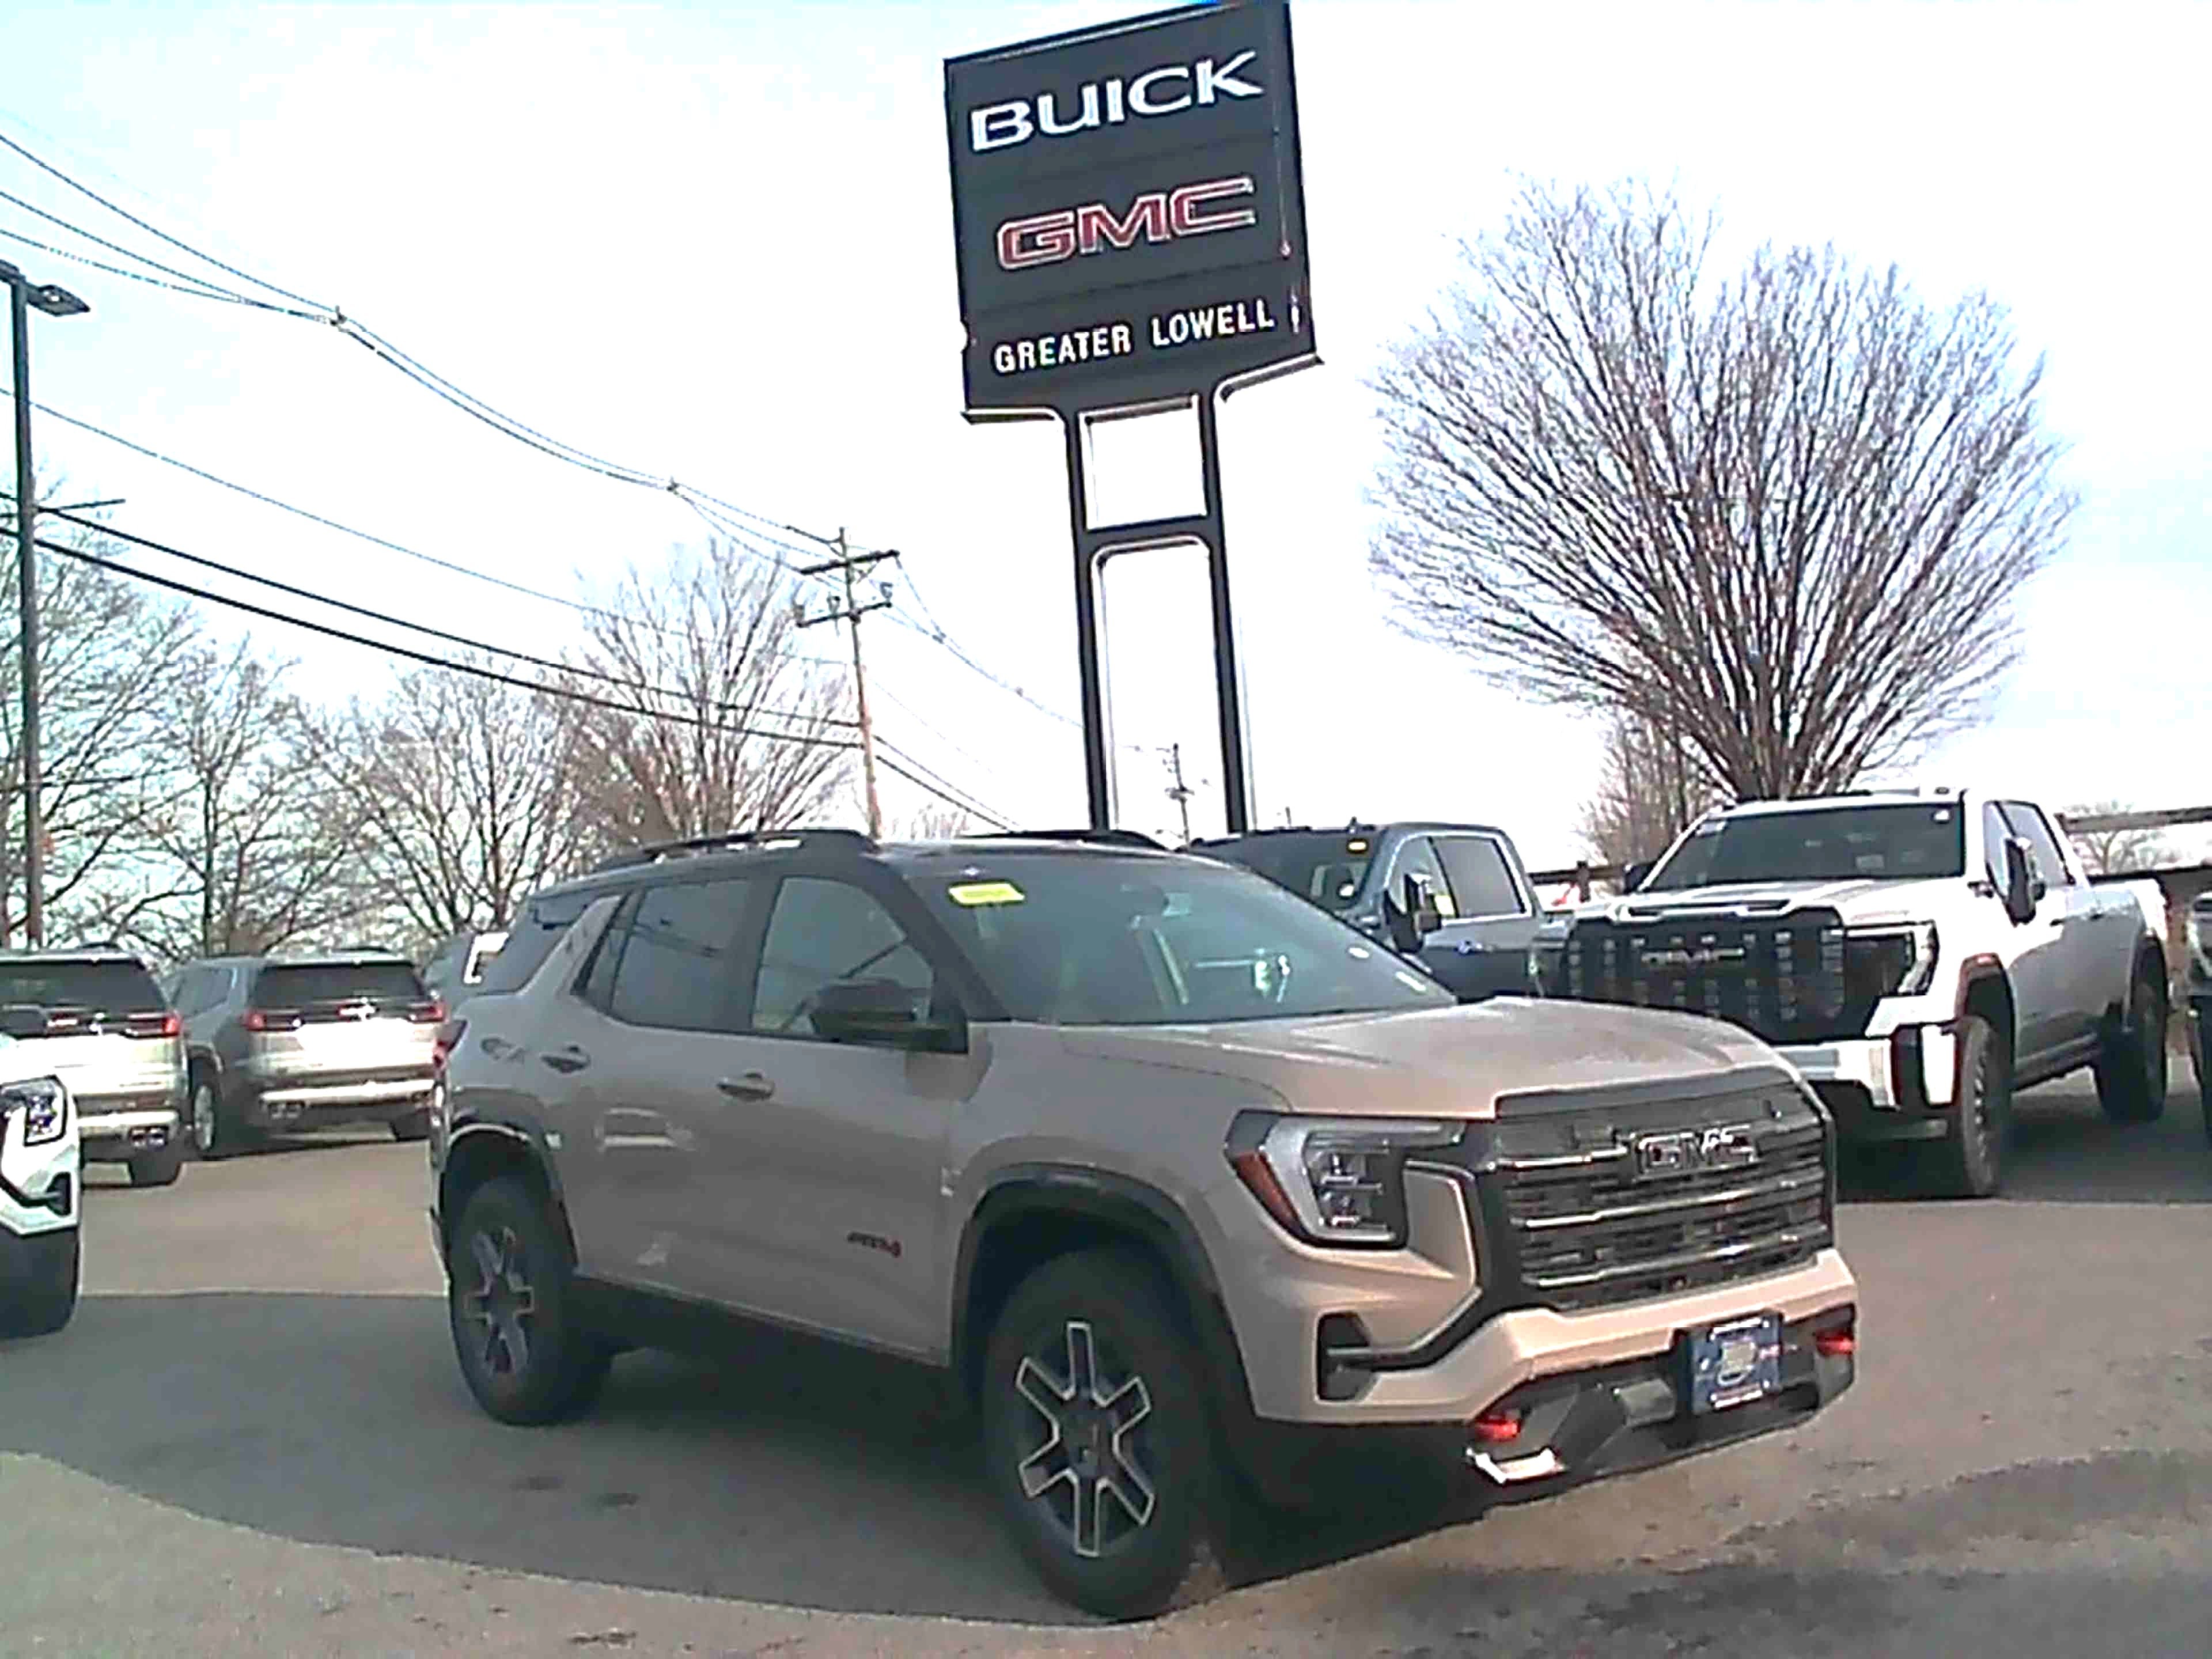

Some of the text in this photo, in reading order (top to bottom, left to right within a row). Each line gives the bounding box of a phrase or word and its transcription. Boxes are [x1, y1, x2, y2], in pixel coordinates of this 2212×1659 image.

[971, 50, 1264, 151] BUICK
[997, 176, 1256, 270] GMC
[994, 297, 1275, 373] GREATER LOWELL
